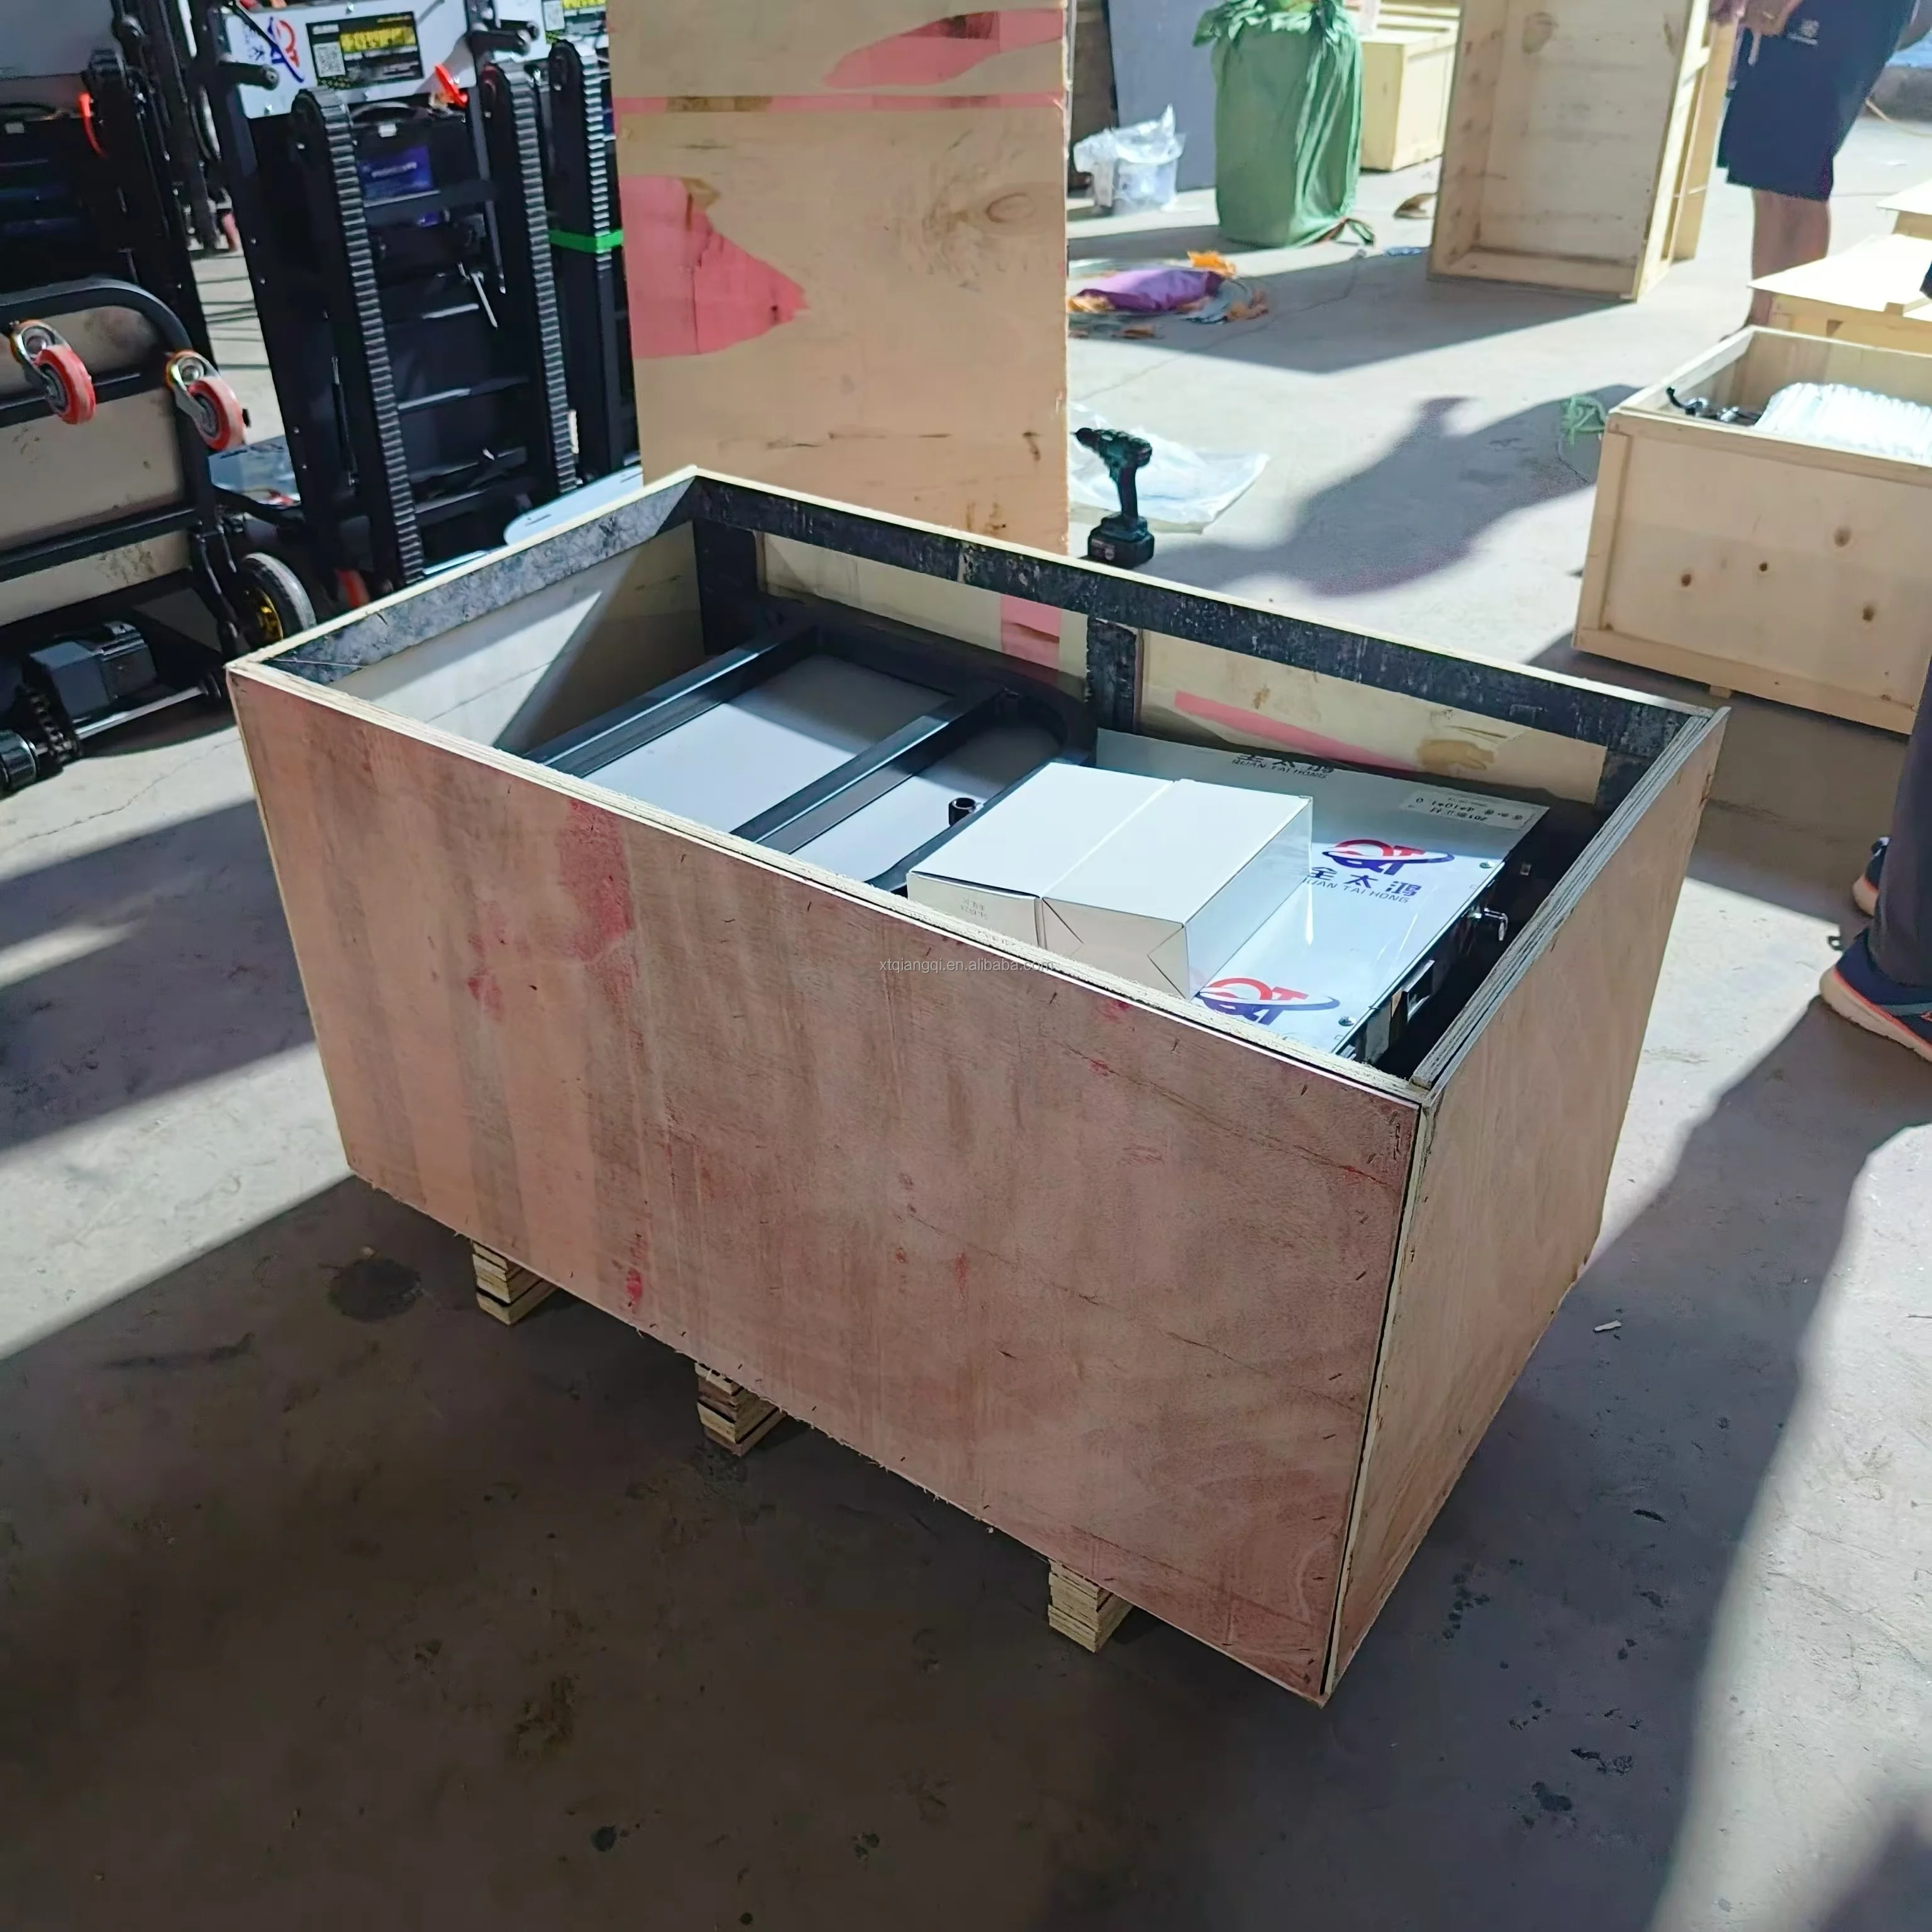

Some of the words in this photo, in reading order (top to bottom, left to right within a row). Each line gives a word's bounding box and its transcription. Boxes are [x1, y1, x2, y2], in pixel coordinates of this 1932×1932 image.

[1309, 867, 1422, 897] 全太鸿
[1344, 885, 1365, 894] TAI
[1369, 891, 1410, 903] HONG
